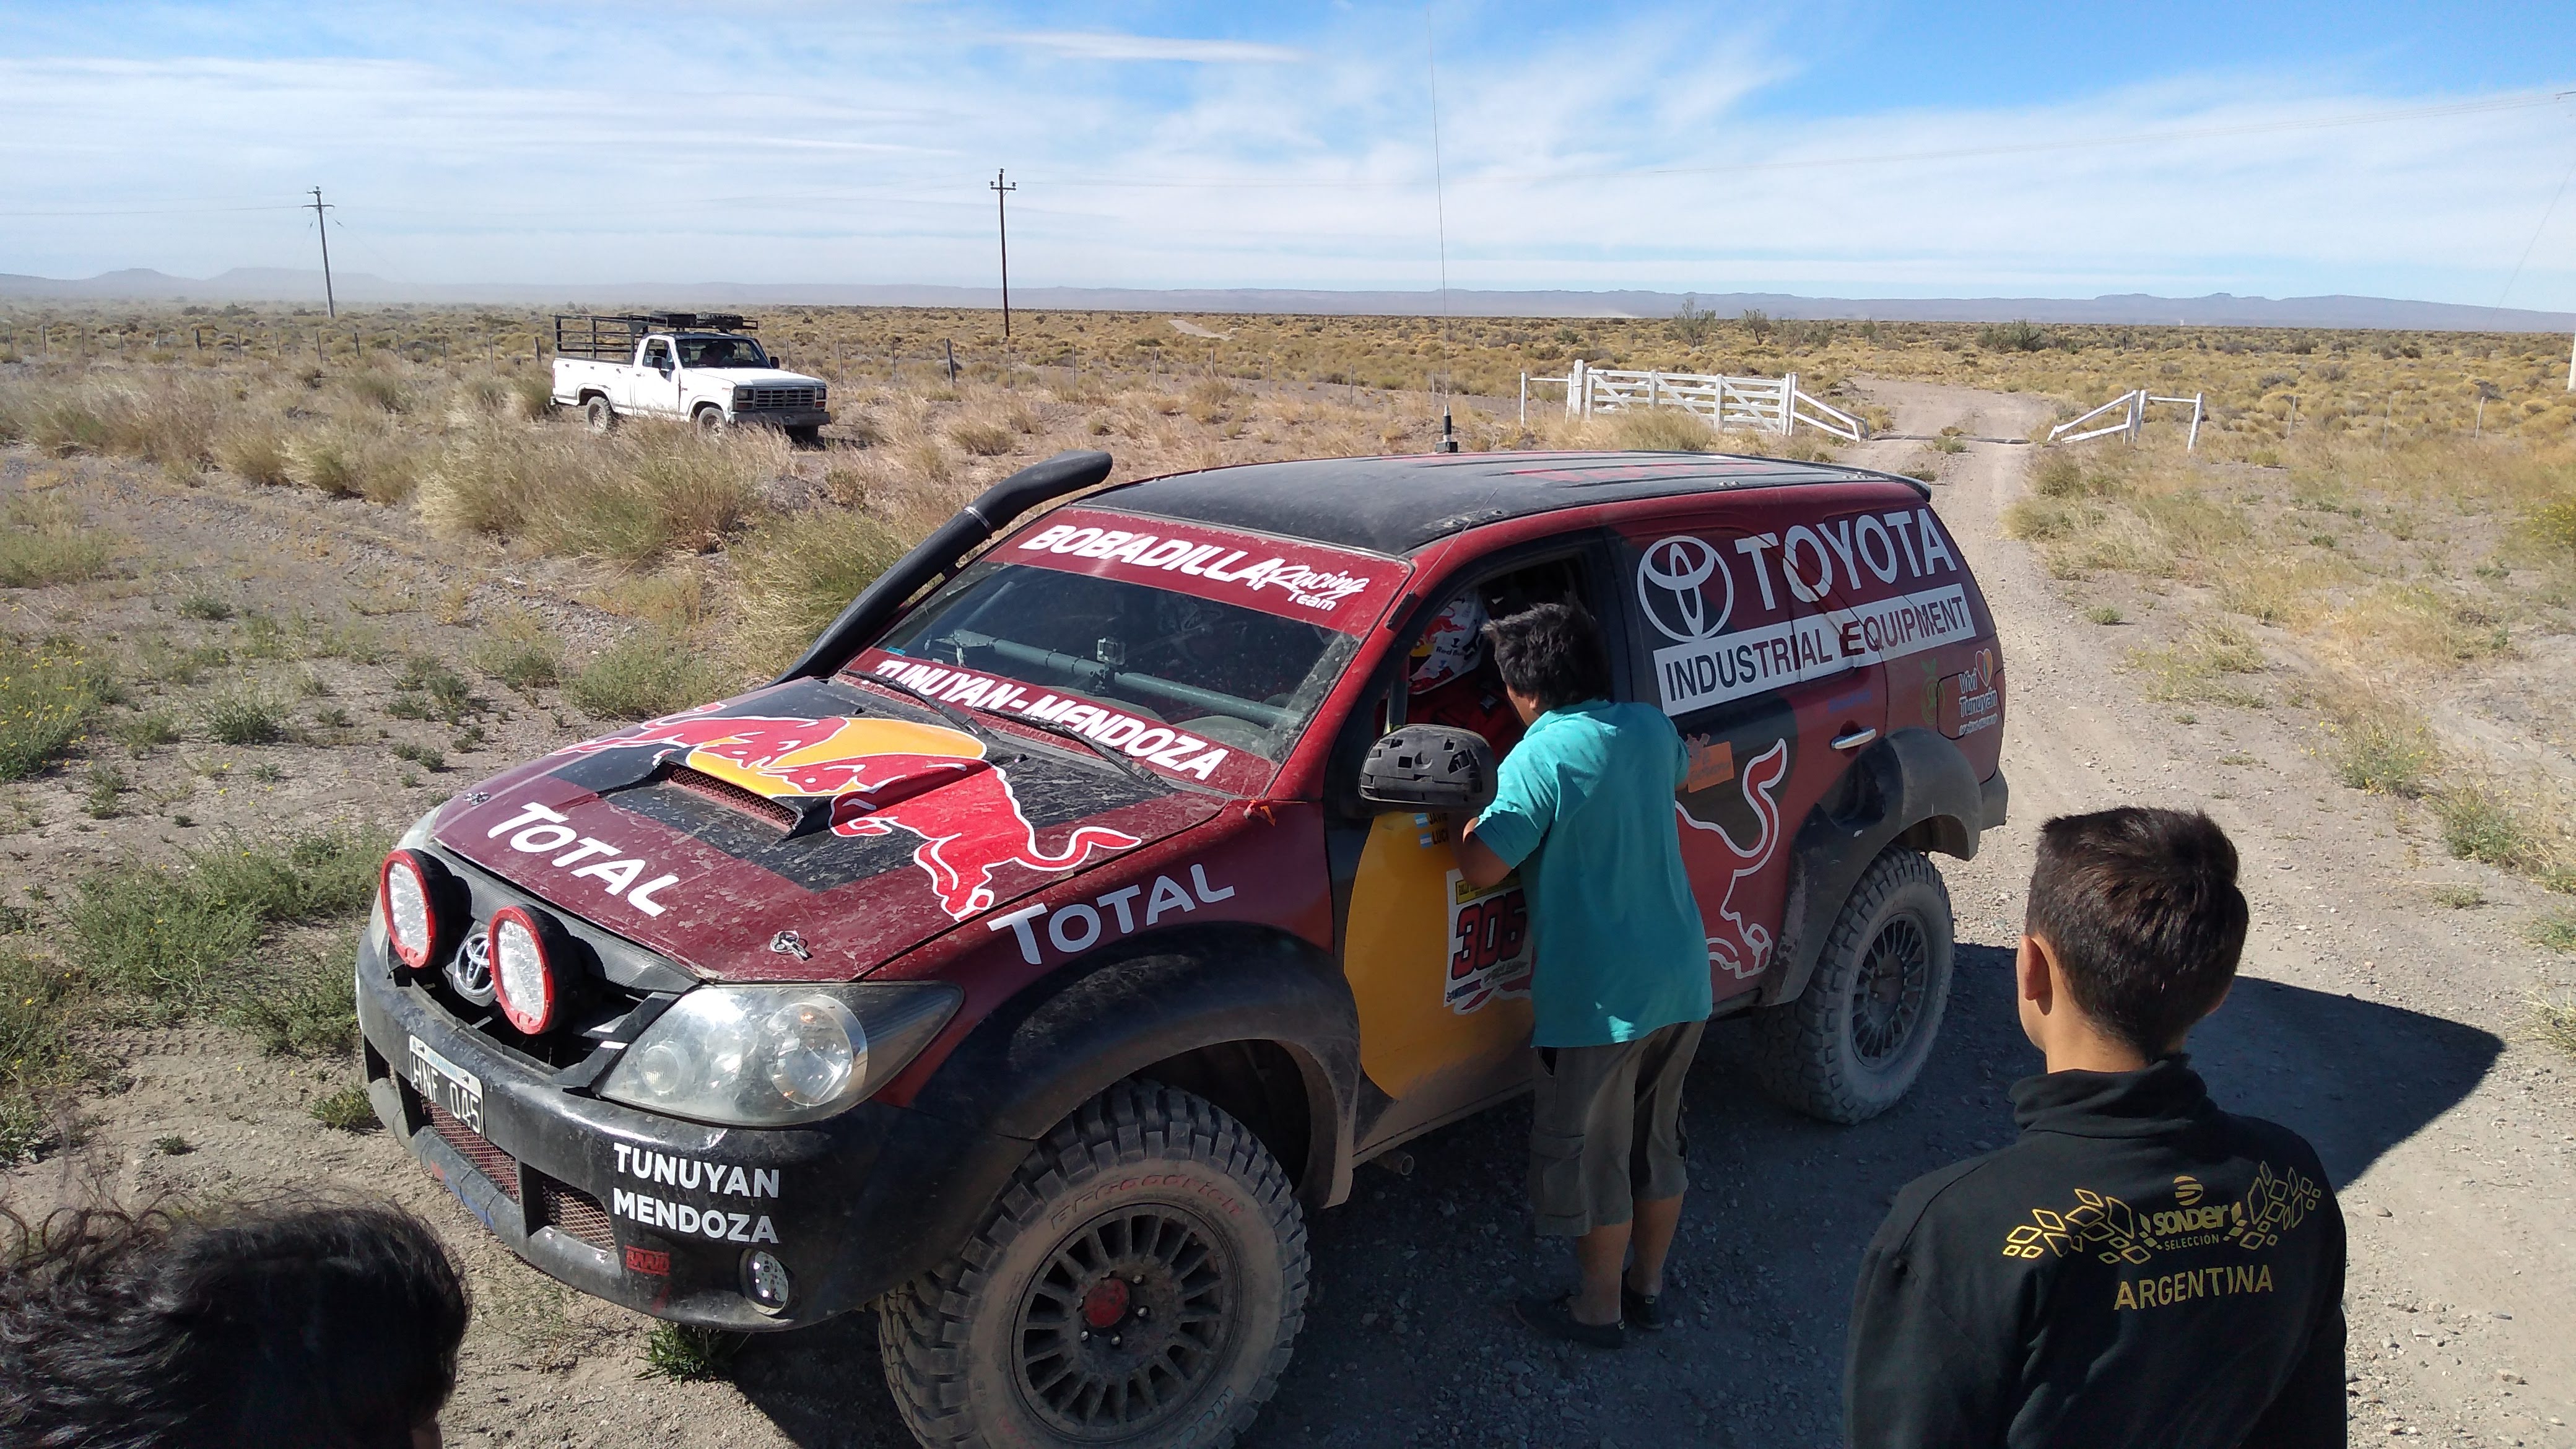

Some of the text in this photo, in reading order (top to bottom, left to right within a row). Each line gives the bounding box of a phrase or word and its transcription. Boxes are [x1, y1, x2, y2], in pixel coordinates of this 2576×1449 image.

[1017, 524, 1370, 598] BOBADILLA Racing
[1735, 508, 1957, 611] TOYOTA
[1286, 588, 1338, 612] Team
[1665, 595, 1969, 702] INDUSTRIAL EQUIPMENT
[487, 801, 680, 918] TOTAL
[986, 863, 1235, 965] TOTAL
[612, 1142, 780, 1199] TUNUYAN
[613, 1187, 779, 1245] MENDOZA
[2113, 1264, 2274, 1311] ARGENTINA
